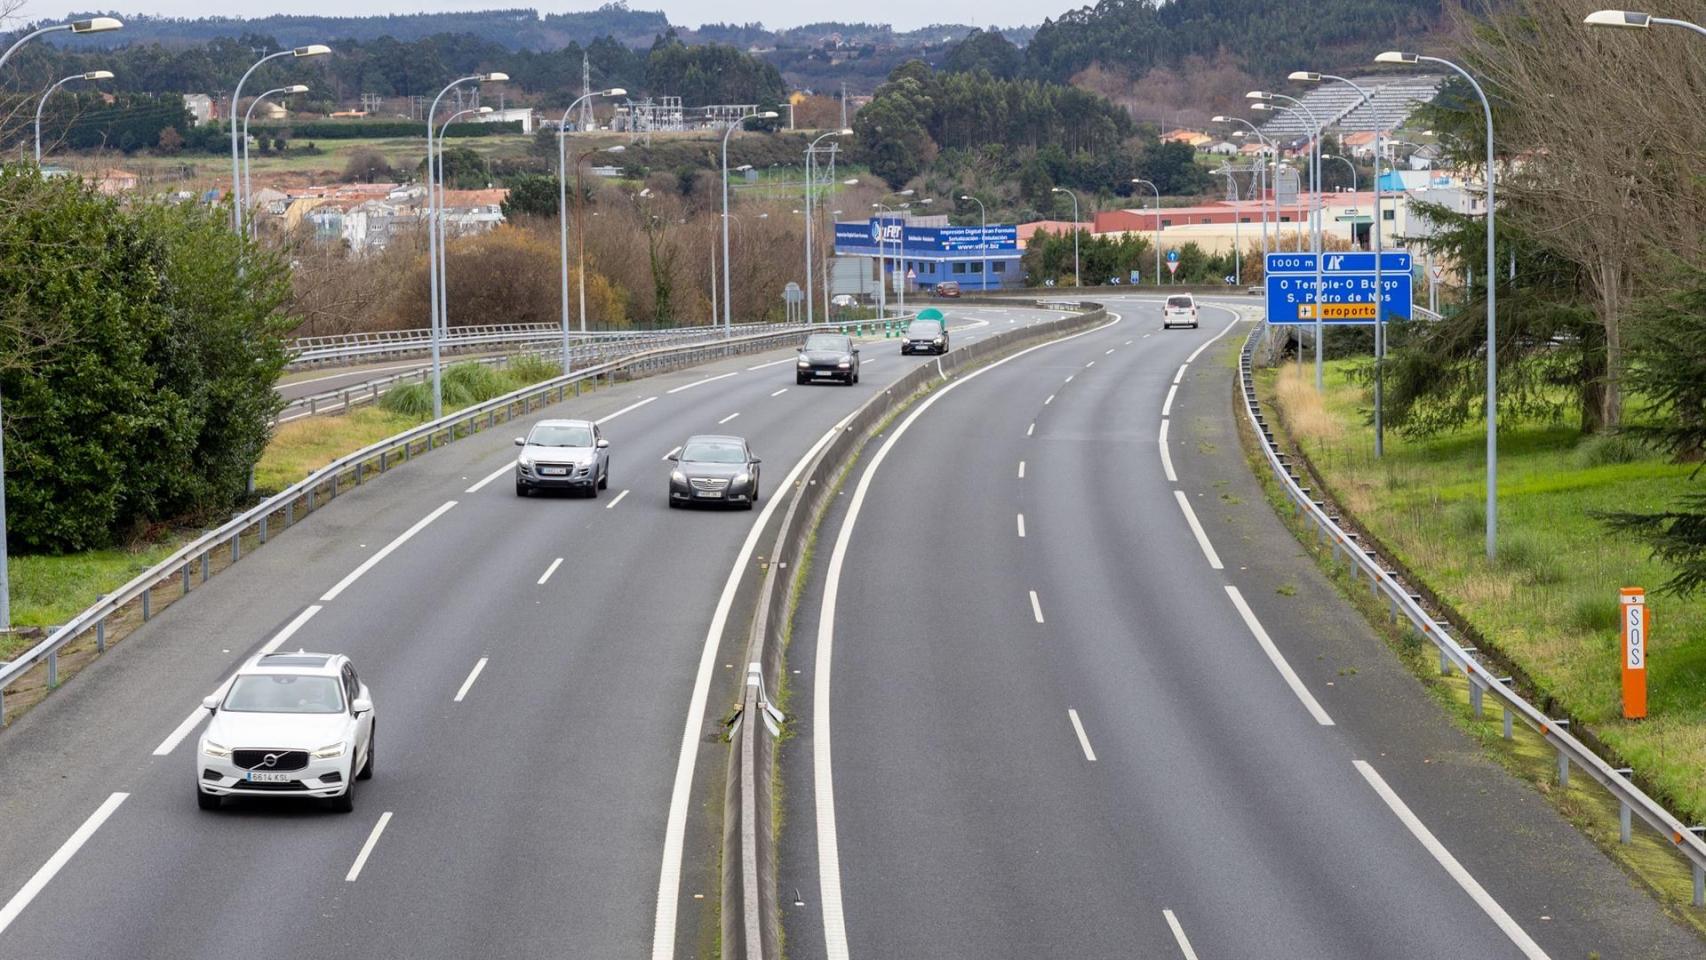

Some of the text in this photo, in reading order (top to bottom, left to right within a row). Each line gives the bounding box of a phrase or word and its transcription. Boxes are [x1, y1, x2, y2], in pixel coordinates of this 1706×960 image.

[957, 242, 999, 250] www.vifr.biz
[1272, 259, 1300, 267] 1000
[1399, 258, 1406, 266] 7
[1280, 280, 1289, 289] O
[1287, 293, 1300, 303] S.
[1348, 293, 1361, 302] de
[1323, 306, 1376, 317] eroporto
[1631, 609, 1640, 665] SOS
